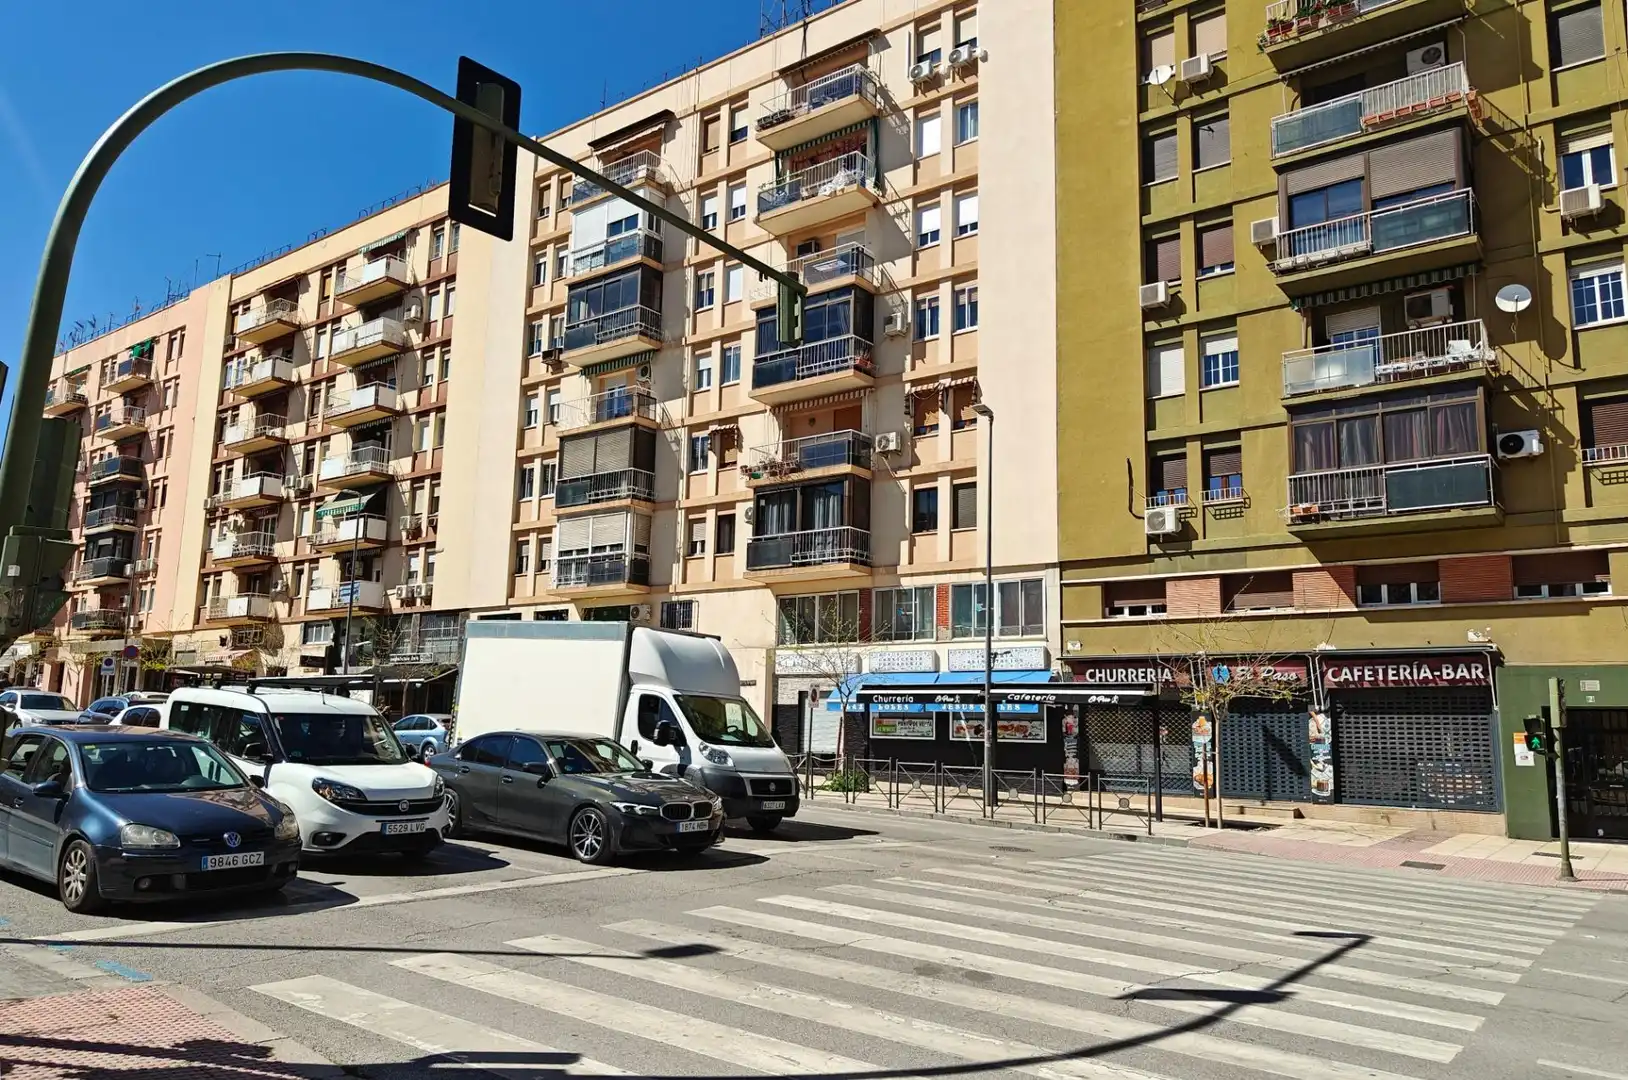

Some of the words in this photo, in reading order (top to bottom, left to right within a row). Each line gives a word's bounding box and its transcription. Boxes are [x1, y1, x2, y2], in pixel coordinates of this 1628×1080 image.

[1260, 666, 1298, 681] Paso
[1328, 661, 1485, 682] CAFETERÍA-BAR
[872, 695, 914, 703] Churrería
[1007, 693, 1056, 703] Cafetería
[942, 703, 975, 711] JESUS
[387, 824, 408, 833] 5529
[410, 822, 425, 832] LVG
[210, 855, 239, 868] 9846
[241, 853, 262, 865] GCZ
